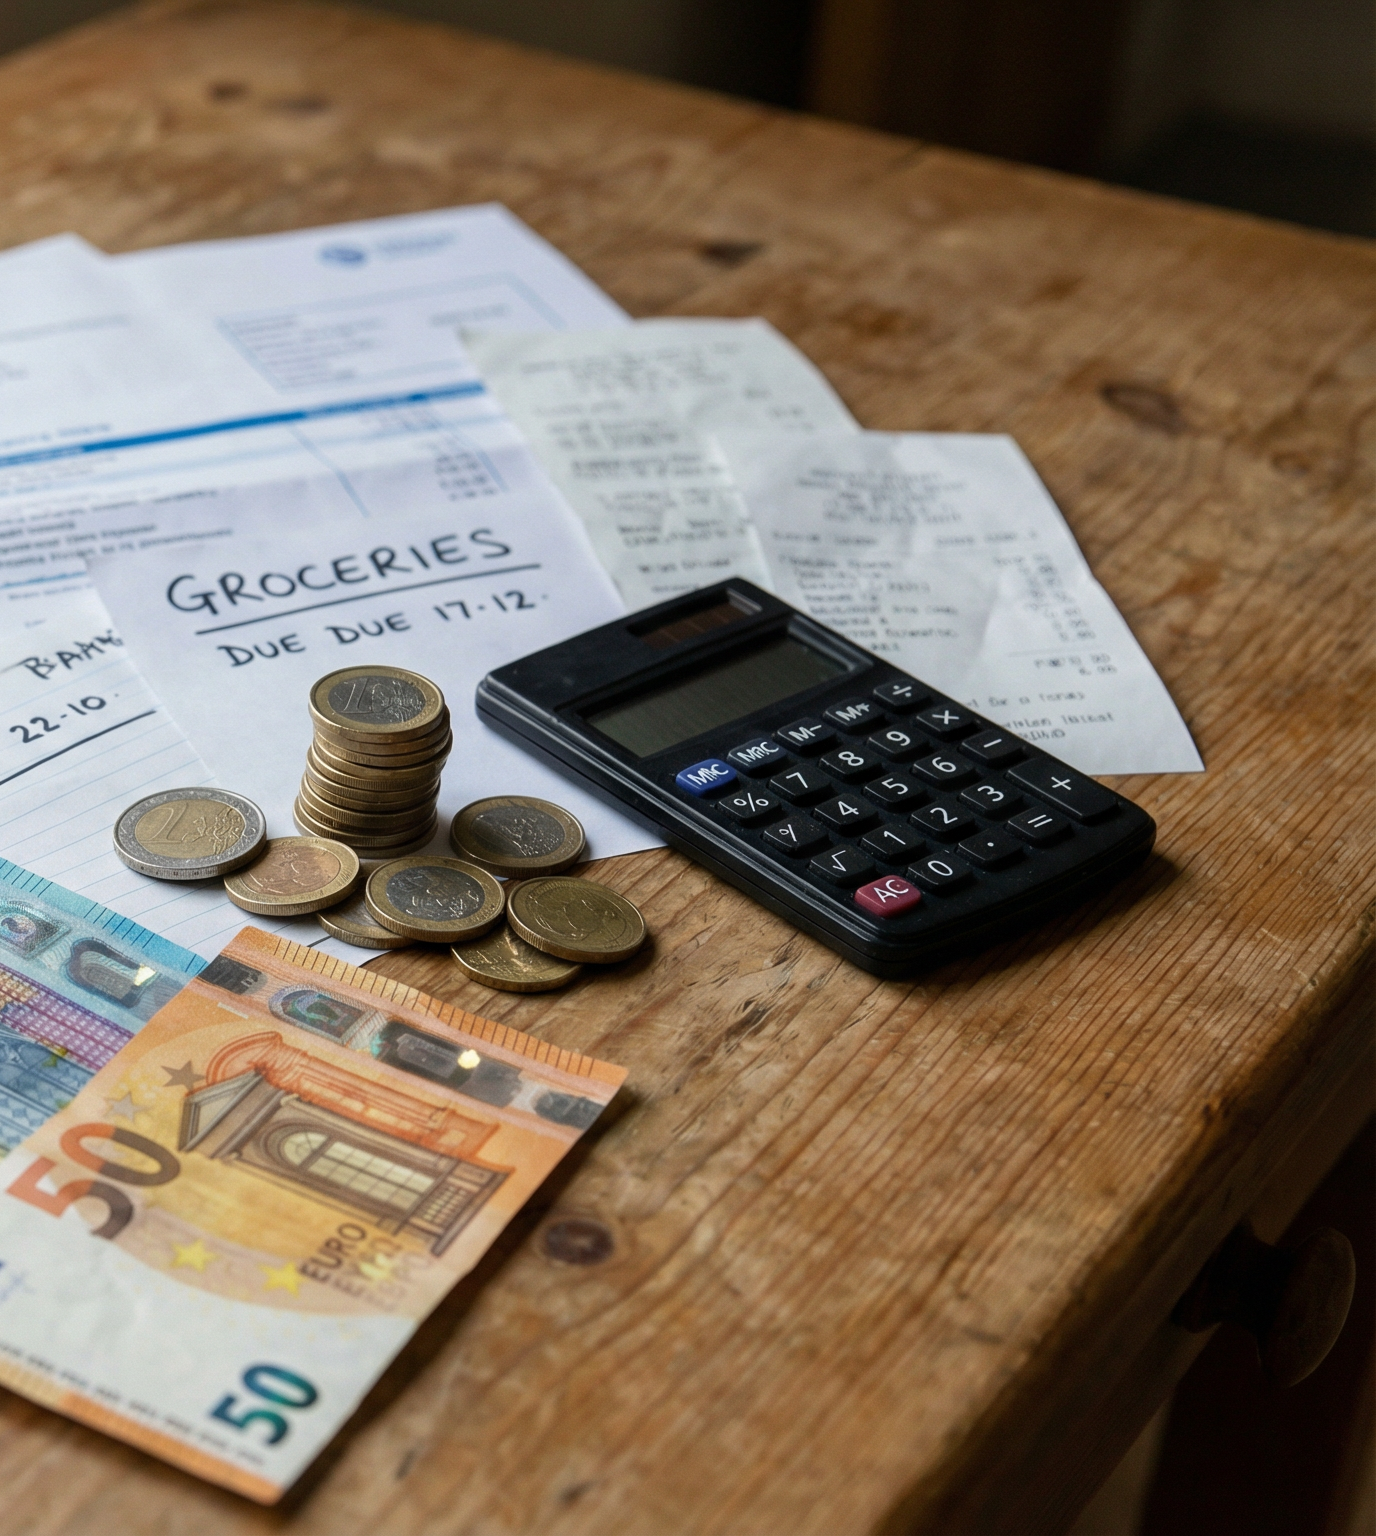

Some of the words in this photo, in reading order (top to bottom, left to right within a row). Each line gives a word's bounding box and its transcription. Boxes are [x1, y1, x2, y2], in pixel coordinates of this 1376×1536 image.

[167, 528, 511, 615] GROCERIES
[218, 634, 306, 668] DUE
[326, 612, 411, 645] DUE
[786, 771, 808, 789] 7
[838, 751, 864, 767] 8
[886, 730, 911, 746] 9
[838, 801, 859, 816] 4
[881, 778, 909, 795] 5
[932, 756, 957, 773] 6
[884, 830, 906, 845] 1
[930, 807, 958, 824] 2
[977, 785, 1005, 802] 3
[873, 879, 909, 903] AC
[927, 860, 954, 876] 0
[6, 1122, 180, 1240] 50
[299, 1222, 367, 1284] EURO
[207, 1362, 320, 1446] 50
